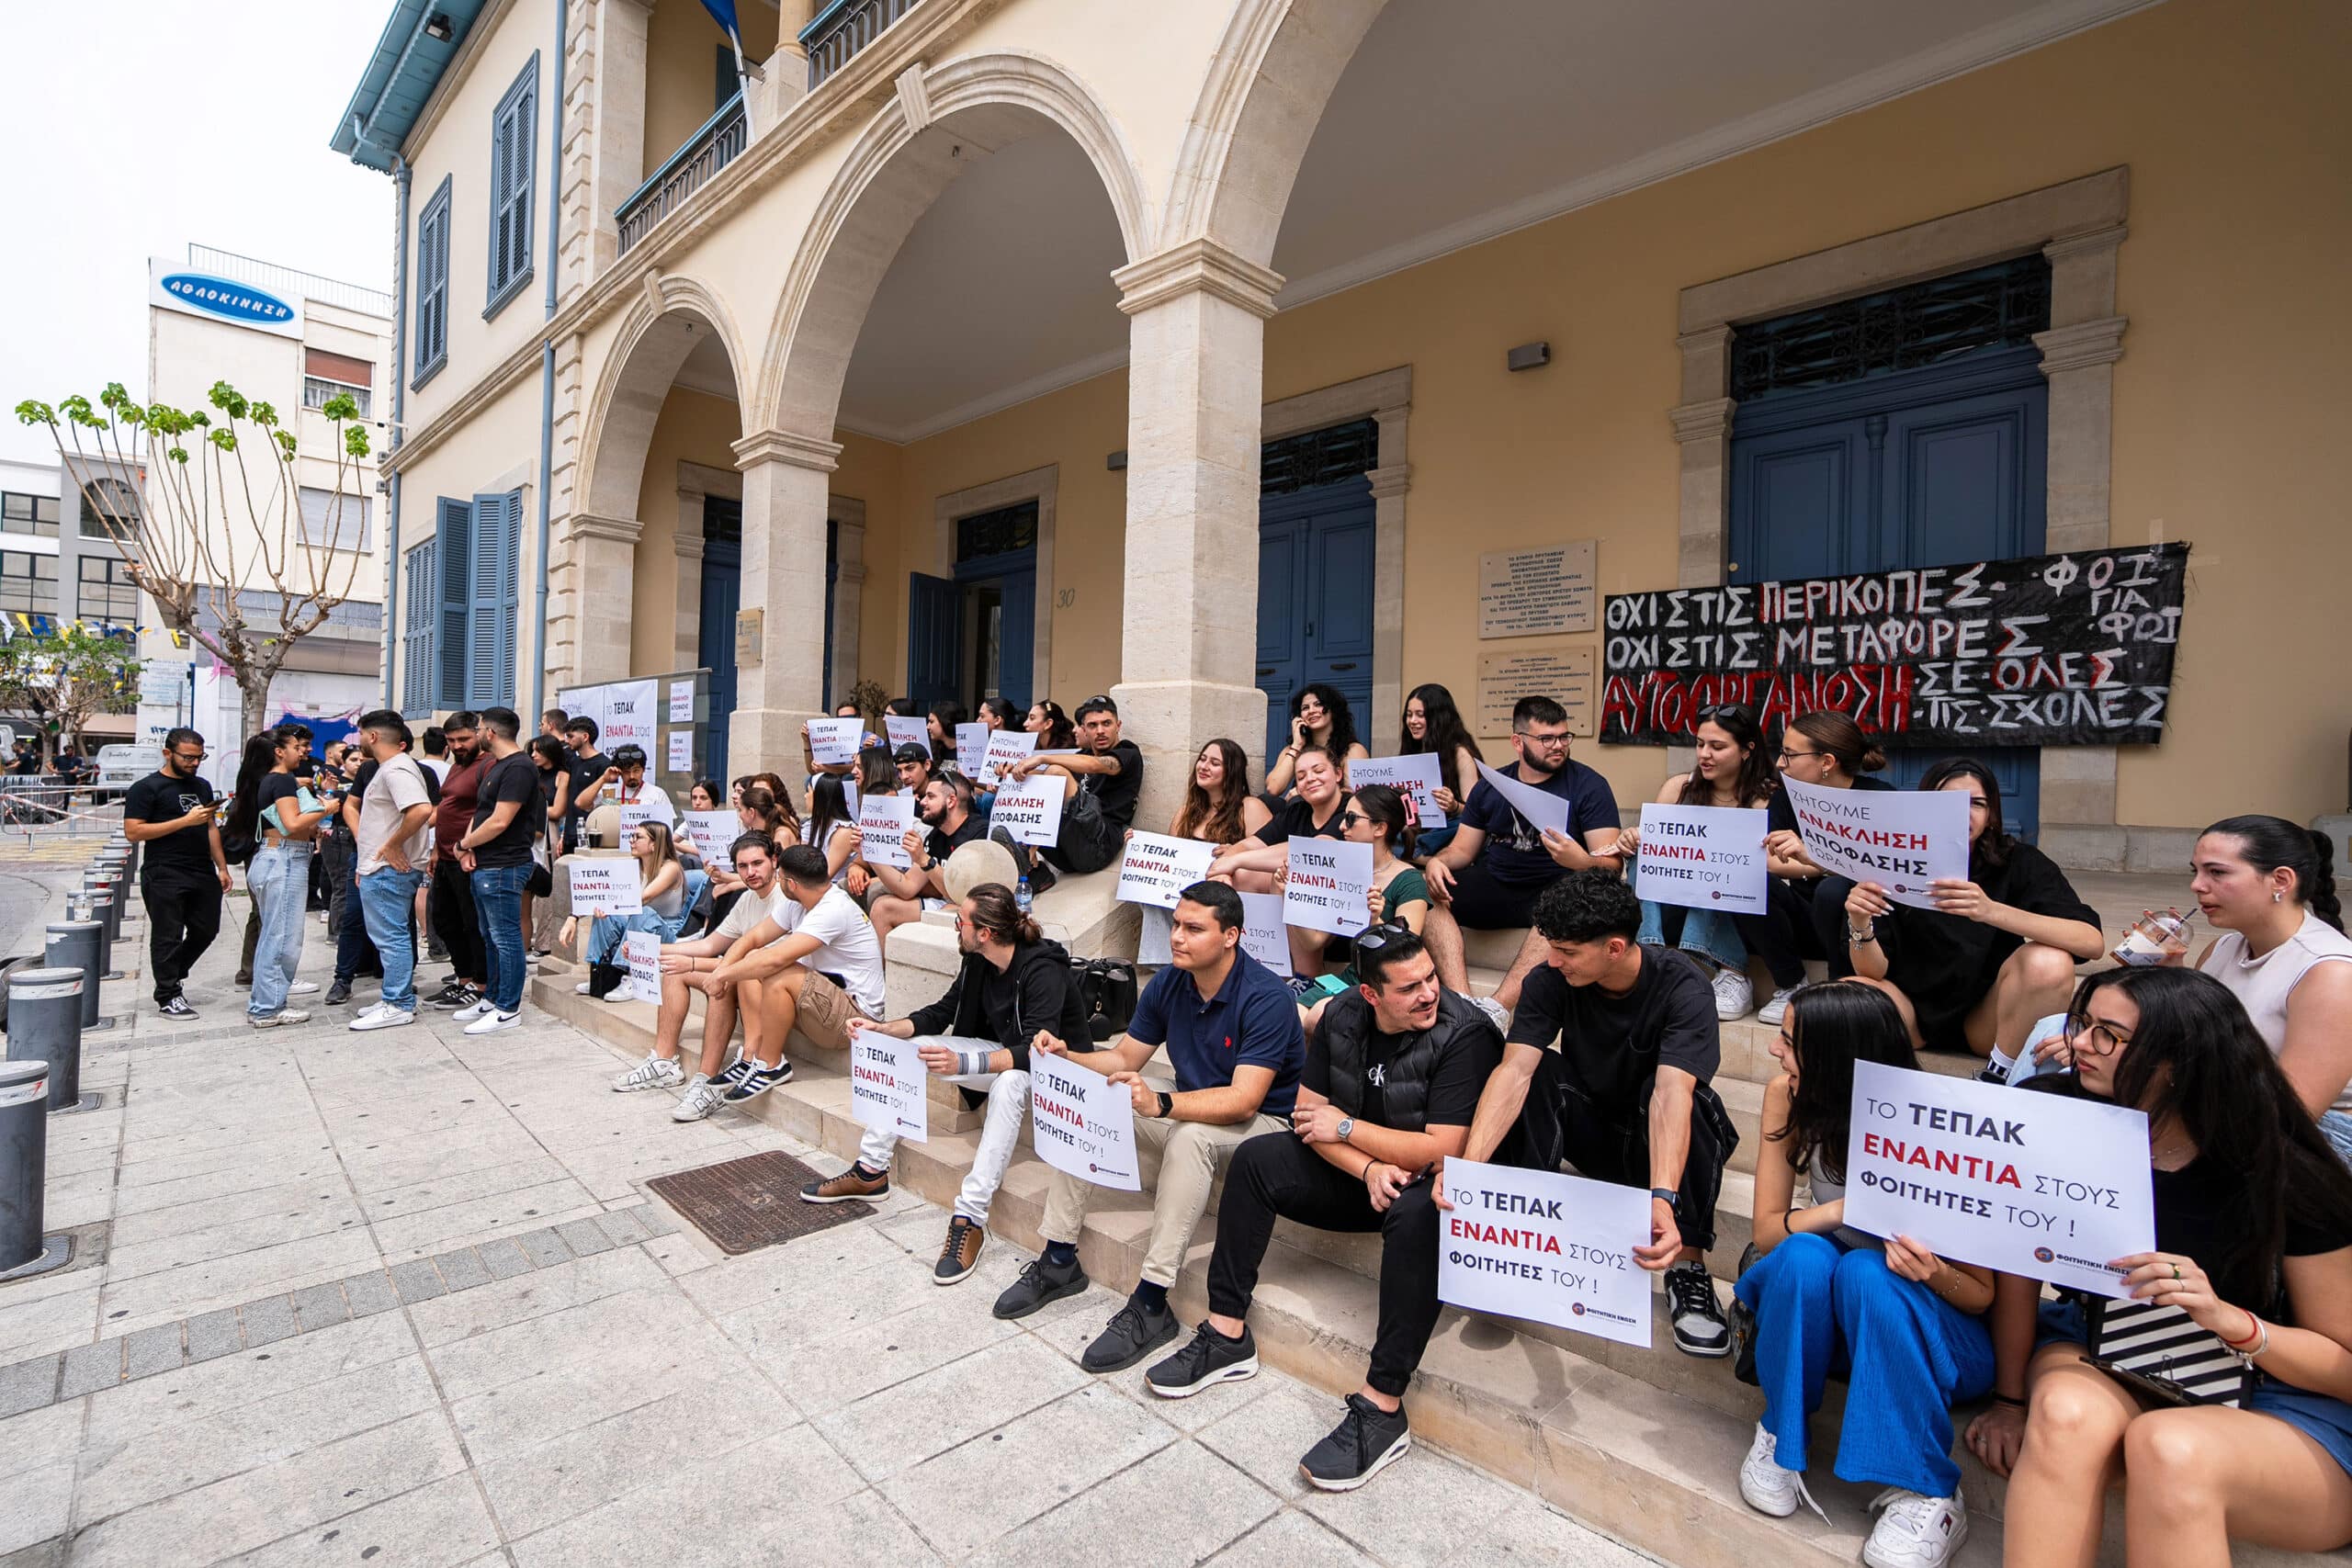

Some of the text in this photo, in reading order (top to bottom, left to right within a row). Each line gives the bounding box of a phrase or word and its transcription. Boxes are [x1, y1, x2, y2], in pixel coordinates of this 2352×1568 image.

[171, 281, 287, 318] ΑΘΛΟΚΙΝΗΣΗ
[1057, 588, 1075, 608] 30
[1608, 562, 1992, 630] ΟΧΙ ΣΤΙΣ ΠΕΡΙΚΟΠΕΣ
[1608, 615, 2050, 669] ΟΧΙ ΣΤΙΣ ΜΕΤΑΦΟΡΕΣ
[1919, 660, 1979, 696] ΣΕ
[1991, 647, 2128, 690] ΟΛΕΣ
[614, 701, 635, 715] ΤΕΠΑΚ
[1987, 686, 2168, 728] ΣΧΟΛΕΣ
[606, 725, 633, 738] ΕΝΑΝΤΙΑ
[1352, 768, 1394, 778] ΖΗΤΟΥΜΕ
[1792, 790, 1871, 820] ΖΗΤΟΥΜΕ
[1645, 821, 1707, 838] ΤΟ ΤΕΠΑΚ
[1799, 809, 1928, 851] ΑΝΑΚΛΗΣΗ
[1143, 843, 1178, 858] ΤΕΠΑΚ
[1302, 852, 1336, 868] ΤΕΠΑΚ
[1642, 843, 1749, 865] ΕΝΑΝΤΙΑ ΣΤΟΥΣ
[1804, 829, 1928, 876] ΑΠΟΦΑΣΗΣ
[1808, 843, 1846, 869] ΤΩΡΑ
[1125, 858, 1170, 873] ΕΝΑΝΤΙΑ
[1641, 864, 1693, 879] ΦΟΙΤΗΤΕΣ
[1699, 871, 1722, 882] ΤΟΥ
[1122, 874, 1158, 886] ΦΟΙΤΗΤΕΣ
[1291, 872, 1363, 895] ΕΝΑΝΤΙΑ ΣΤΟΥΣ
[1288, 891, 1328, 906] ΦΟΙΤΗΤΕΣ
[1250, 928, 1276, 940] ΣΤΟΥΣ
[866, 1047, 896, 1066] ΤΕΠΑΚ
[854, 1066, 918, 1096] ΕΝΑΝΤΙΑ ΣΤΟΥΣ
[1048, 1074, 1086, 1102] ΤΕΠΑΚ
[854, 1086, 888, 1104] ΦΟΙΤΗΤΕΣ
[1034, 1092, 1120, 1142] ΕΝΑΝΤΙΑ ΣΤΟΥΣ
[1867, 1098, 2026, 1145] ΤΟ ΤΕΠΑΚ
[1035, 1117, 1074, 1145] ΦΟΙΤΗΤΕΣ
[1078, 1138, 1096, 1155] ΤΟΥ
[1864, 1133, 2120, 1209] ΕΝΑΝΤΙΑ ΣΤΟΥΣ
[1453, 1189, 1563, 1220] ΤΟ ΤΕΠΑΚ
[1860, 1170, 1992, 1218] ΦΟΙΤΗΤΕΣ
[2005, 1206, 2057, 1232] ΤΟΥ
[1451, 1218, 1626, 1270] ΕΝΑΝΤΙΑ ΣΤΟΥΣ
[1449, 1250, 1543, 1280] ΦΟΙΤΗΤΕΣ
[1551, 1269, 1586, 1289] ΤΟΥ
[2056, 1254, 2102, 1269] ΦΟΙΤΗΤΙΚΗ
